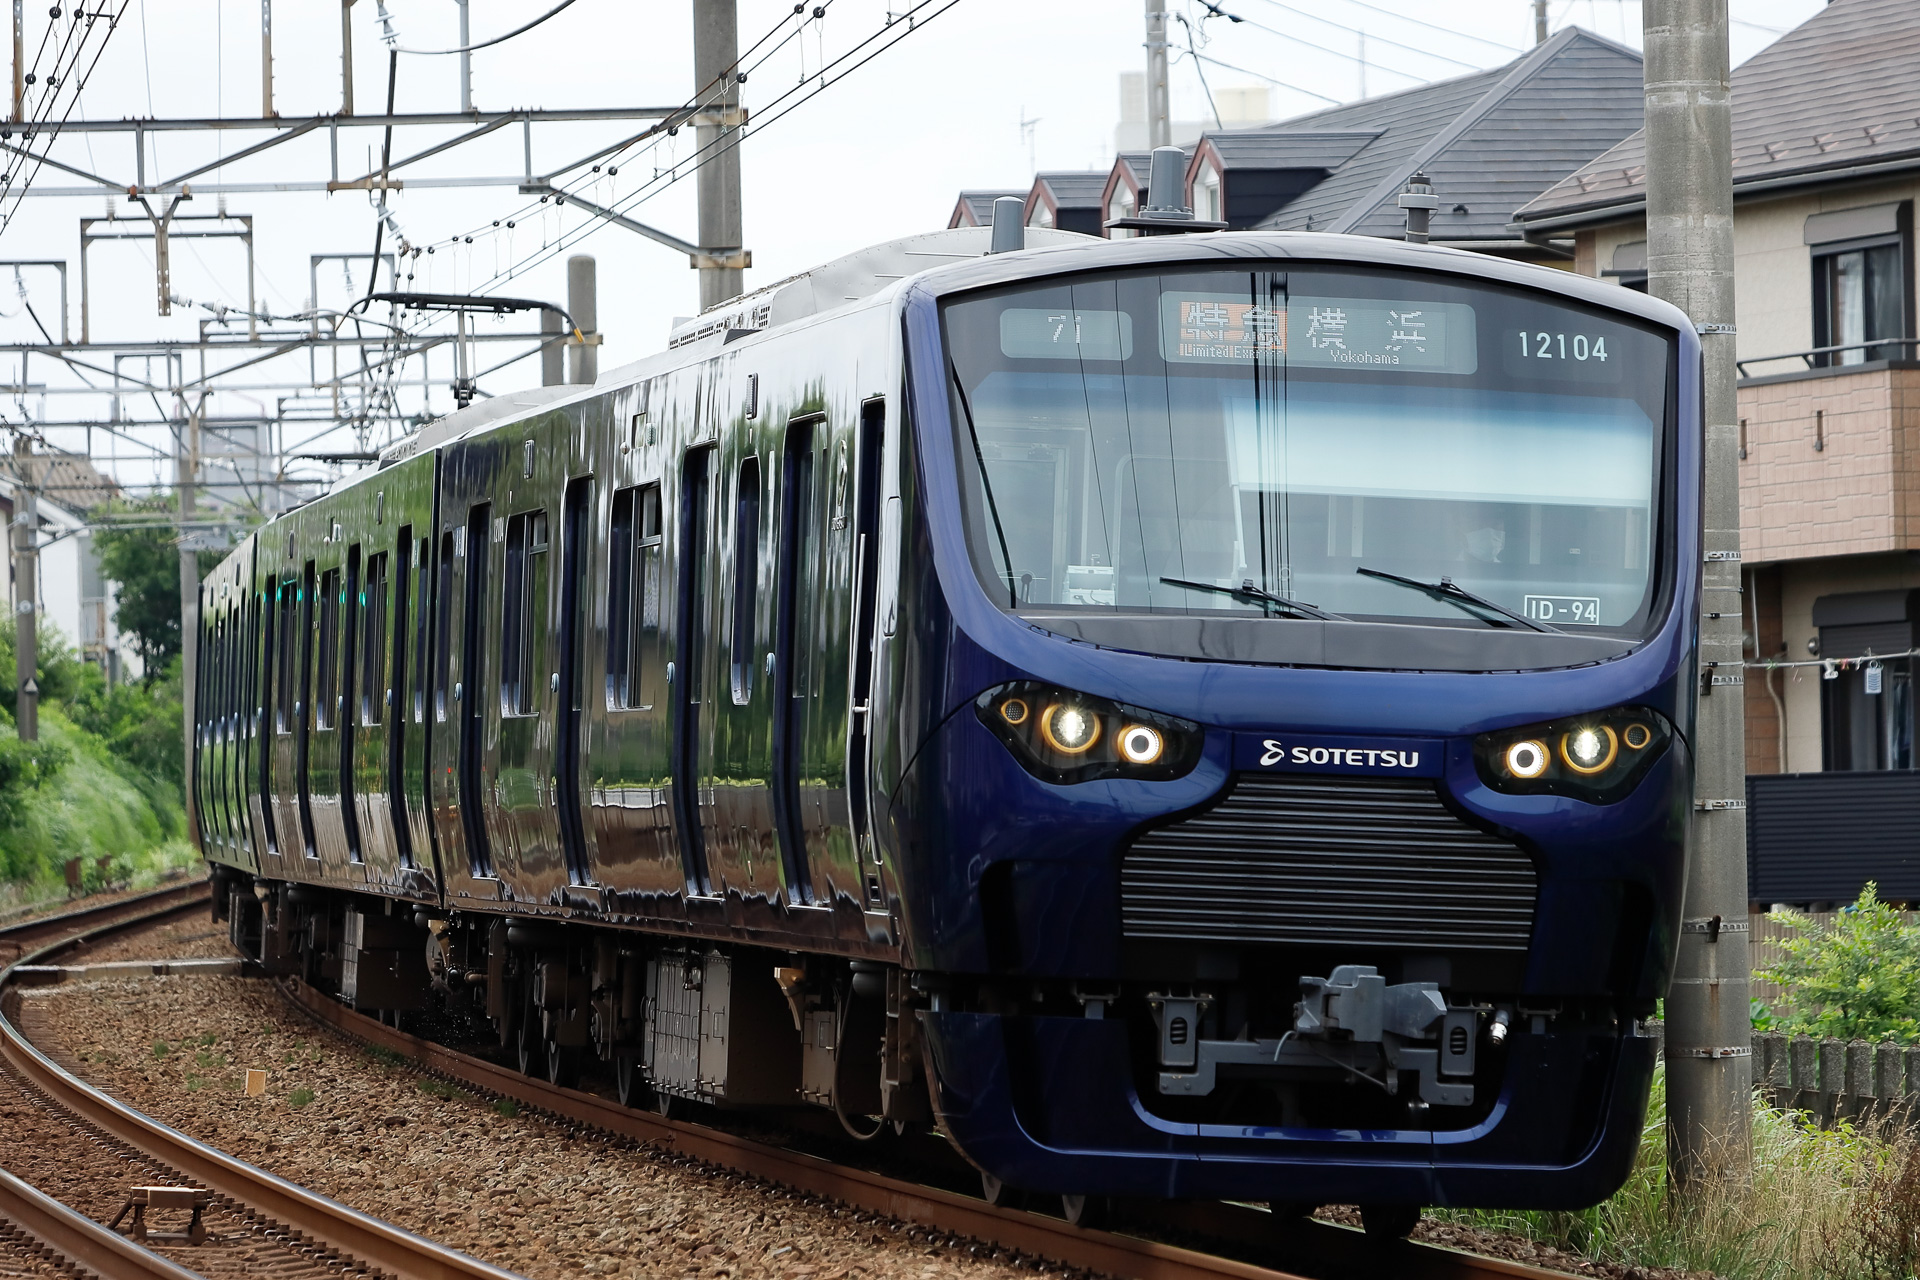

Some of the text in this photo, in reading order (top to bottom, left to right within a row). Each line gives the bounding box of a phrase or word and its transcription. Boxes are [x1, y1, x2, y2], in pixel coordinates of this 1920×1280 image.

[1187, 302, 1281, 346] 特急
[1184, 343, 1229, 358] Limited
[1330, 349, 1400, 365] Yokohama
[1519, 331, 1608, 362] 12104
[1291, 746, 1419, 769] SOTETSU
